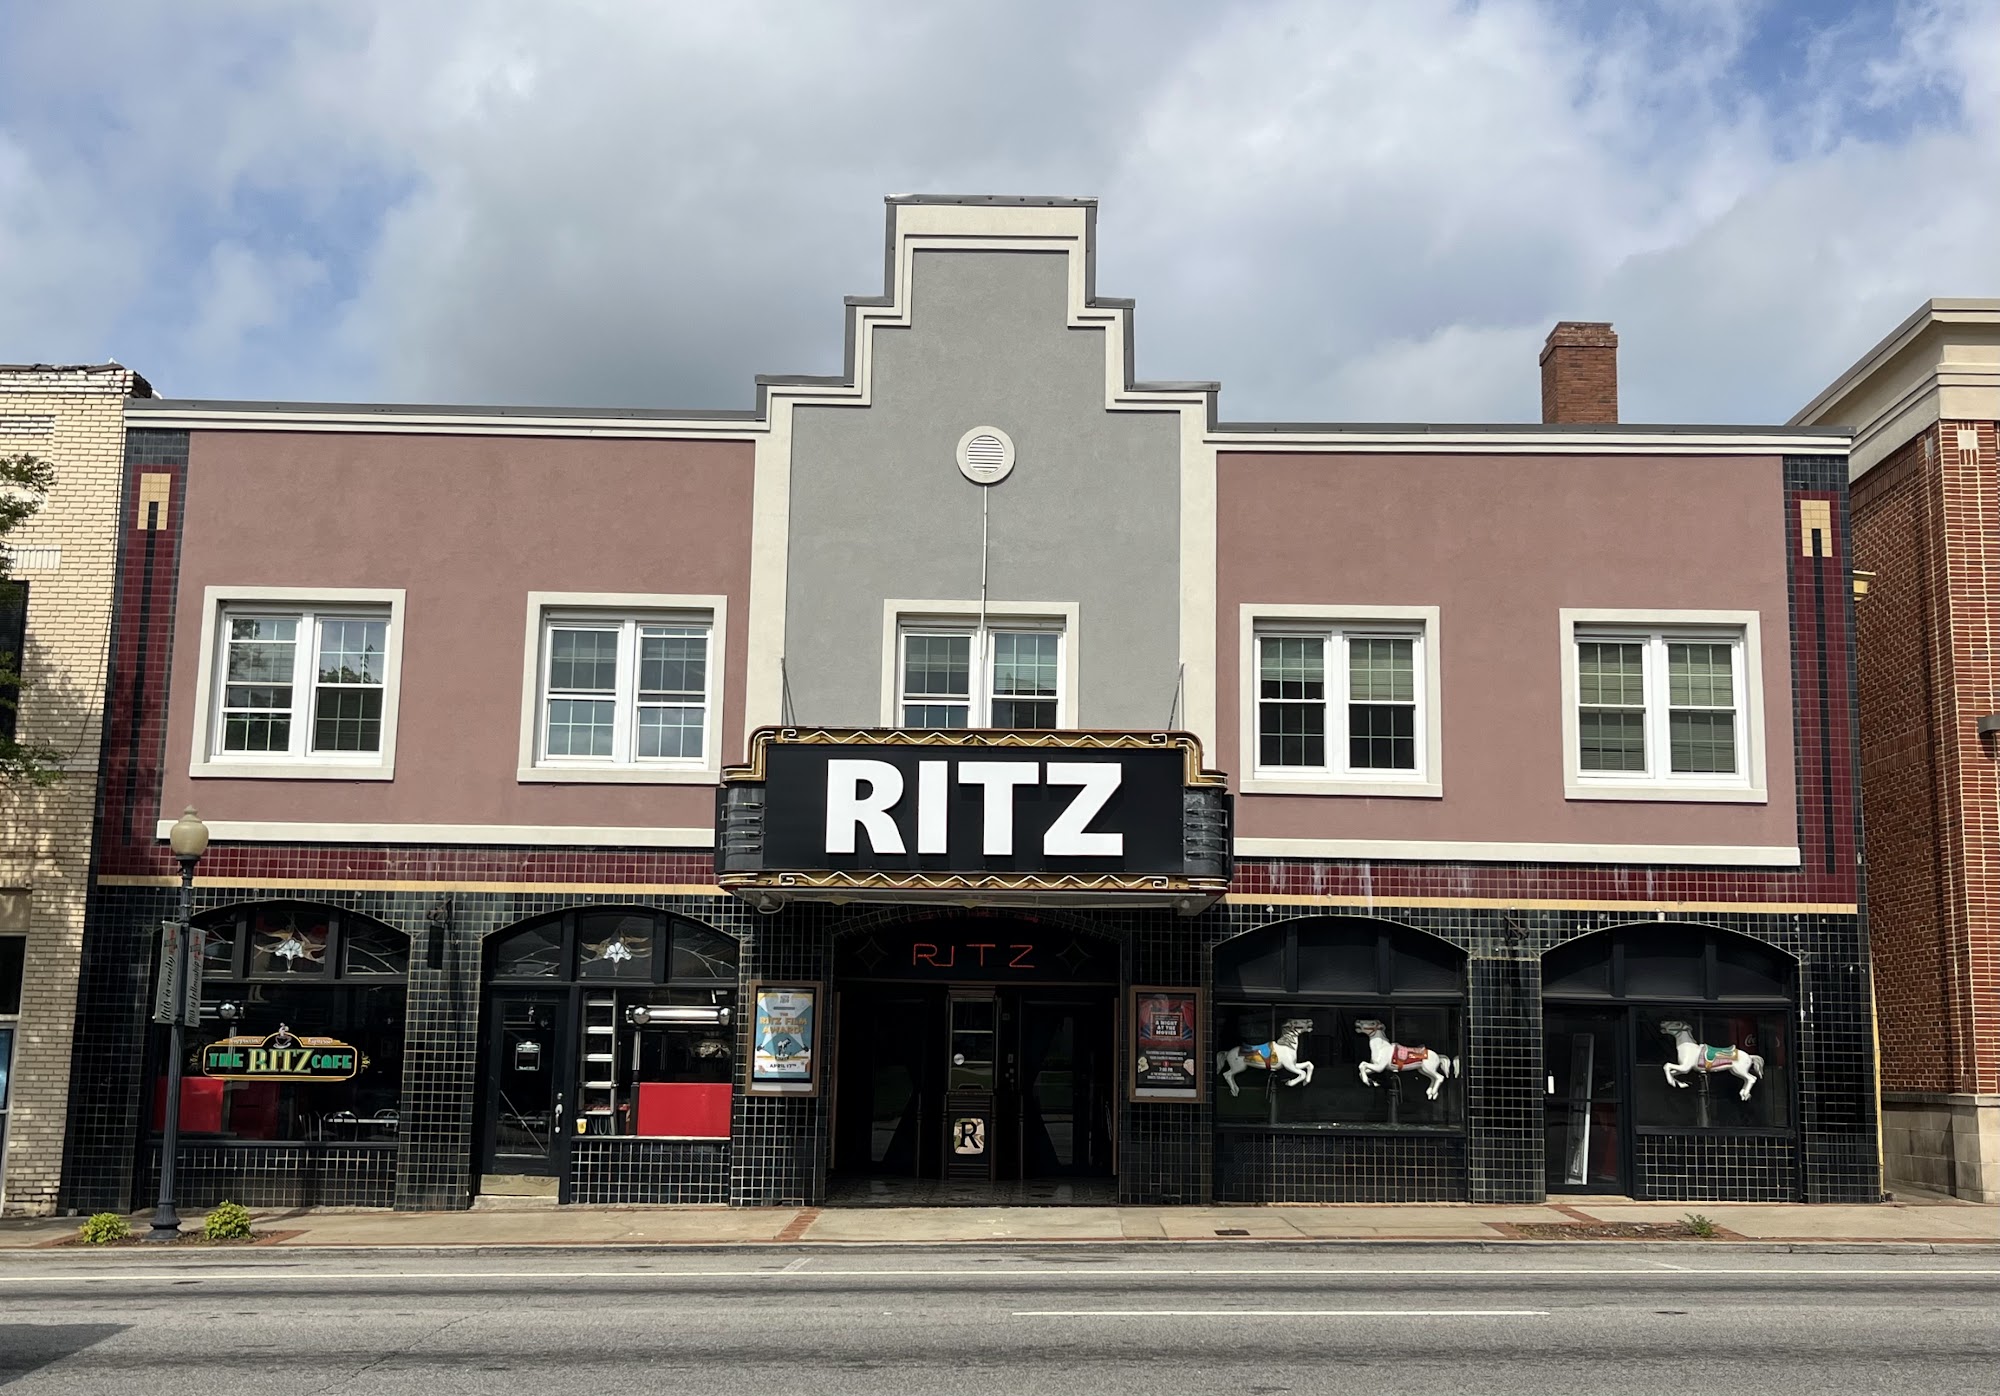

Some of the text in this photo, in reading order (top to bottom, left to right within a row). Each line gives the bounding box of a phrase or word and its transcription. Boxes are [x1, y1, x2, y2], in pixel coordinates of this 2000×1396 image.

[825, 758, 1124, 857] RITZ
[912, 943, 1035, 968] RITZ
[761, 1017, 808, 1026] RITZ FILM
[209, 1048, 353, 1074] THE RITZ CAFE
[958, 1121, 981, 1149] R
